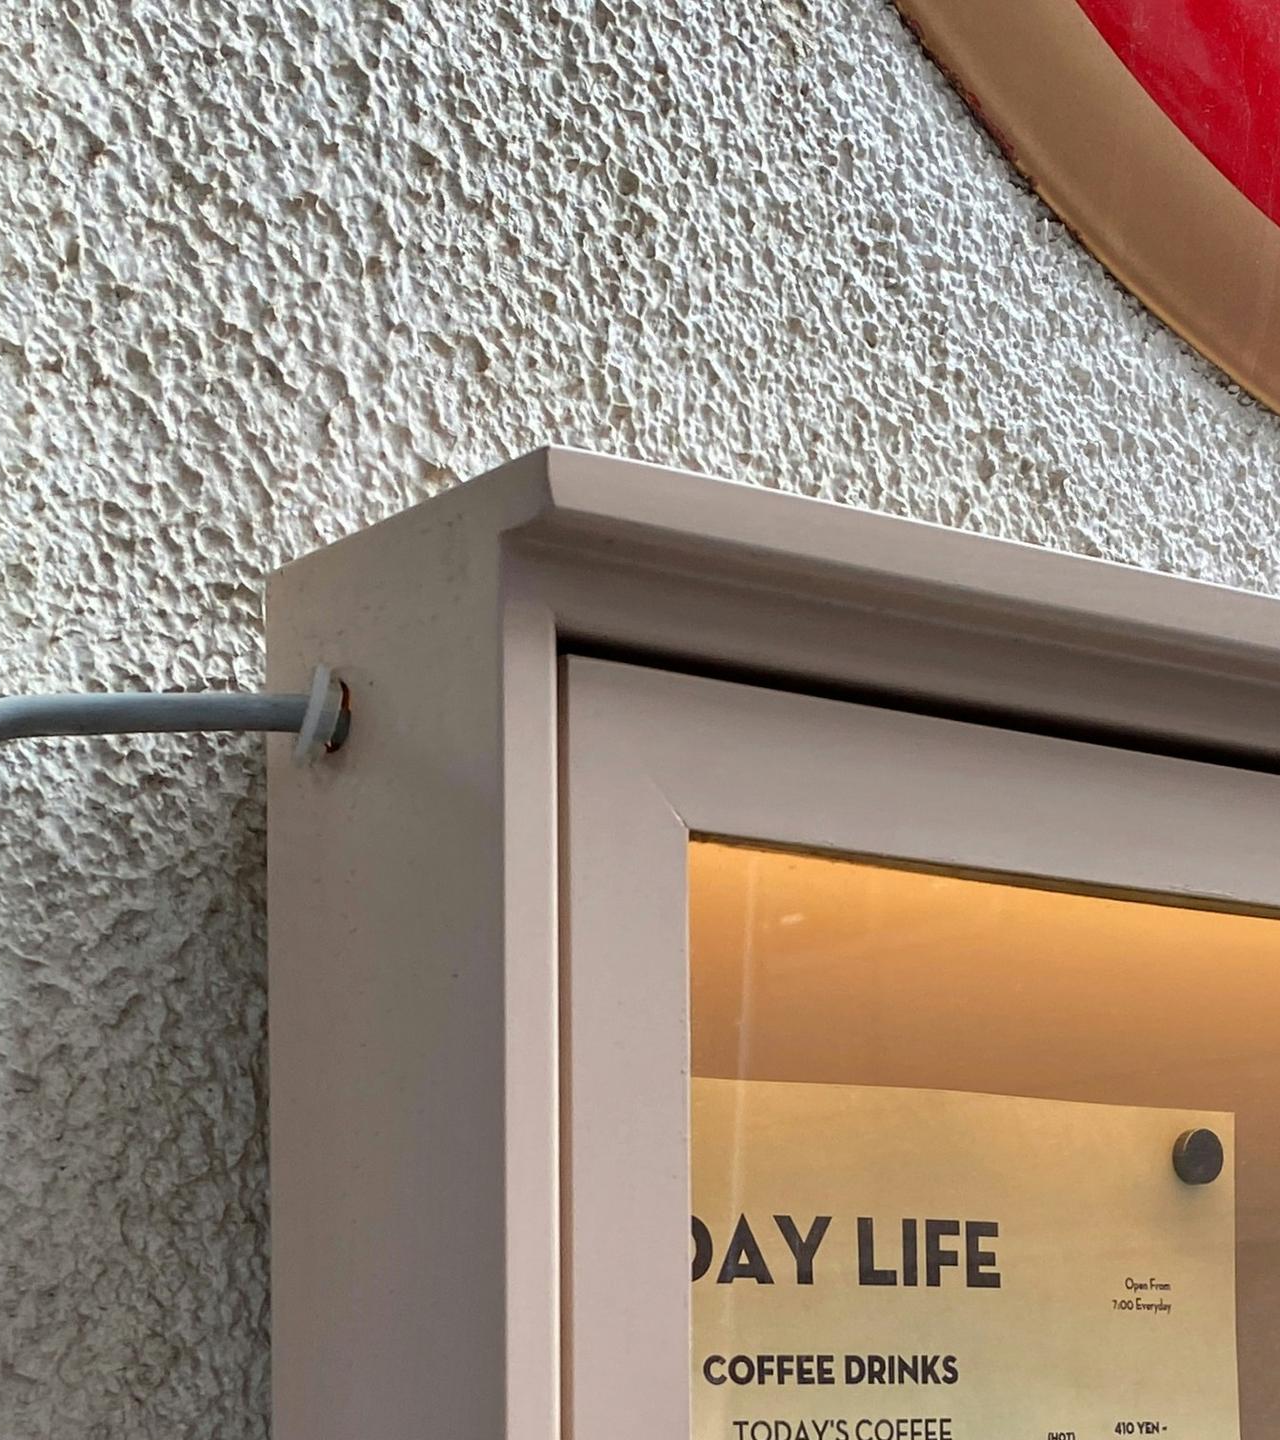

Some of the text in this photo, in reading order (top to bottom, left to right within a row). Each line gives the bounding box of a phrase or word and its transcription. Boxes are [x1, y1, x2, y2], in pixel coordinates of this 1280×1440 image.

[857, 1217, 1001, 1288] LIFE
[1125, 1277, 1170, 1292] Open From
[1112, 1299, 1171, 1314] 7:00 Everyday
[703, 1354, 959, 1385] COFFEE DRINKS
[1115, 1423, 1134, 1436] 410
[1137, 1422, 1160, 1435] YEN
